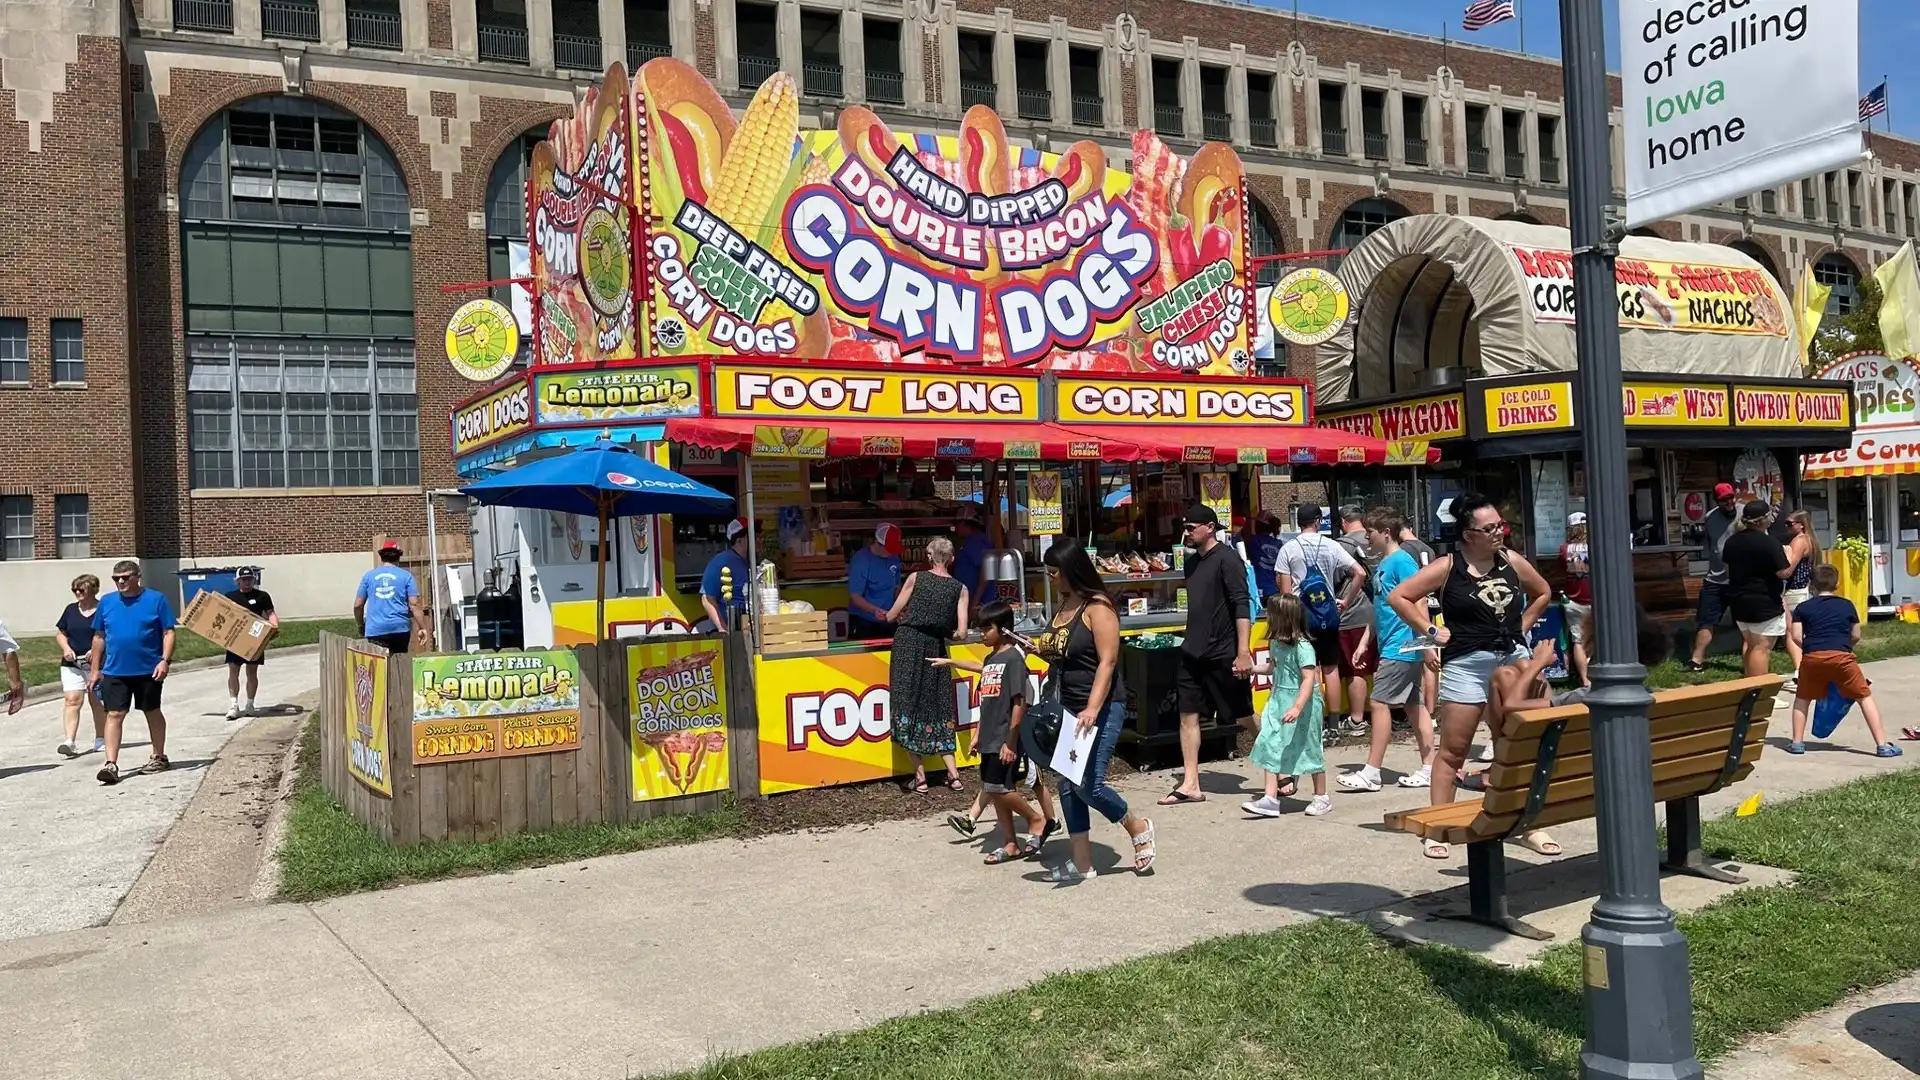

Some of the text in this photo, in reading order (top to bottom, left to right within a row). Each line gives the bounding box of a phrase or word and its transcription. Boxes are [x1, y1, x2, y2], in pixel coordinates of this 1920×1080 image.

[1644, 5, 1808, 84] of calling
[1646, 79, 1725, 127] Iowa
[1648, 117, 1745, 169] home
[891, 150, 966, 215] HAND
[679, 203, 747, 255] DEEP
[838, 158, 1110, 262] DOUBLE BACON
[535, 207, 577, 275] CORN
[691, 264, 757, 321] CORN
[698, 245, 773, 301] SWEET
[790, 193, 1154, 355] CORN DOGS
[652, 234, 796, 352] CORN DOGS
[1533, 282, 1577, 315] COR
[1687, 296, 1755, 327] NACHOS
[1152, 340, 1209, 367] CORN
[1209, 286, 1245, 353] DOGS
[1162, 291, 1224, 343] CHEESE
[548, 380, 692, 407] Lemonade
[577, 374, 660, 387] STATE FAIR
[735, 372, 1023, 415] FOOT LONG
[1500, 389, 1551, 406] ICE COLD
[457, 386, 530, 445] CORN DOGS
[1072, 385, 1295, 421] CORN DOGS
[1377, 399, 1460, 441] WAGON
[1497, 403, 1558, 428] DRINKS
[1682, 388, 1725, 420] WEST
[1736, 390, 1846, 423] COWBOY COOKIN'
[688, 446, 715, 460] 3.00
[1030, 506, 1063, 516] CORN DOGS
[421, 665, 573, 701] Lemonade
[456, 656, 544, 673] STATE FAIR
[636, 665, 715, 701] DOUBLE
[503, 714, 577, 729] Polish Sausage
[639, 685, 719, 720] BACON
[786, 684, 892, 751] FOO
[425, 722, 488, 736] Sweet Corn
[503, 725, 577, 750] CORNDOG
[636, 713, 723, 733] CORNDOGS
[416, 732, 496, 758] CORNDOG
